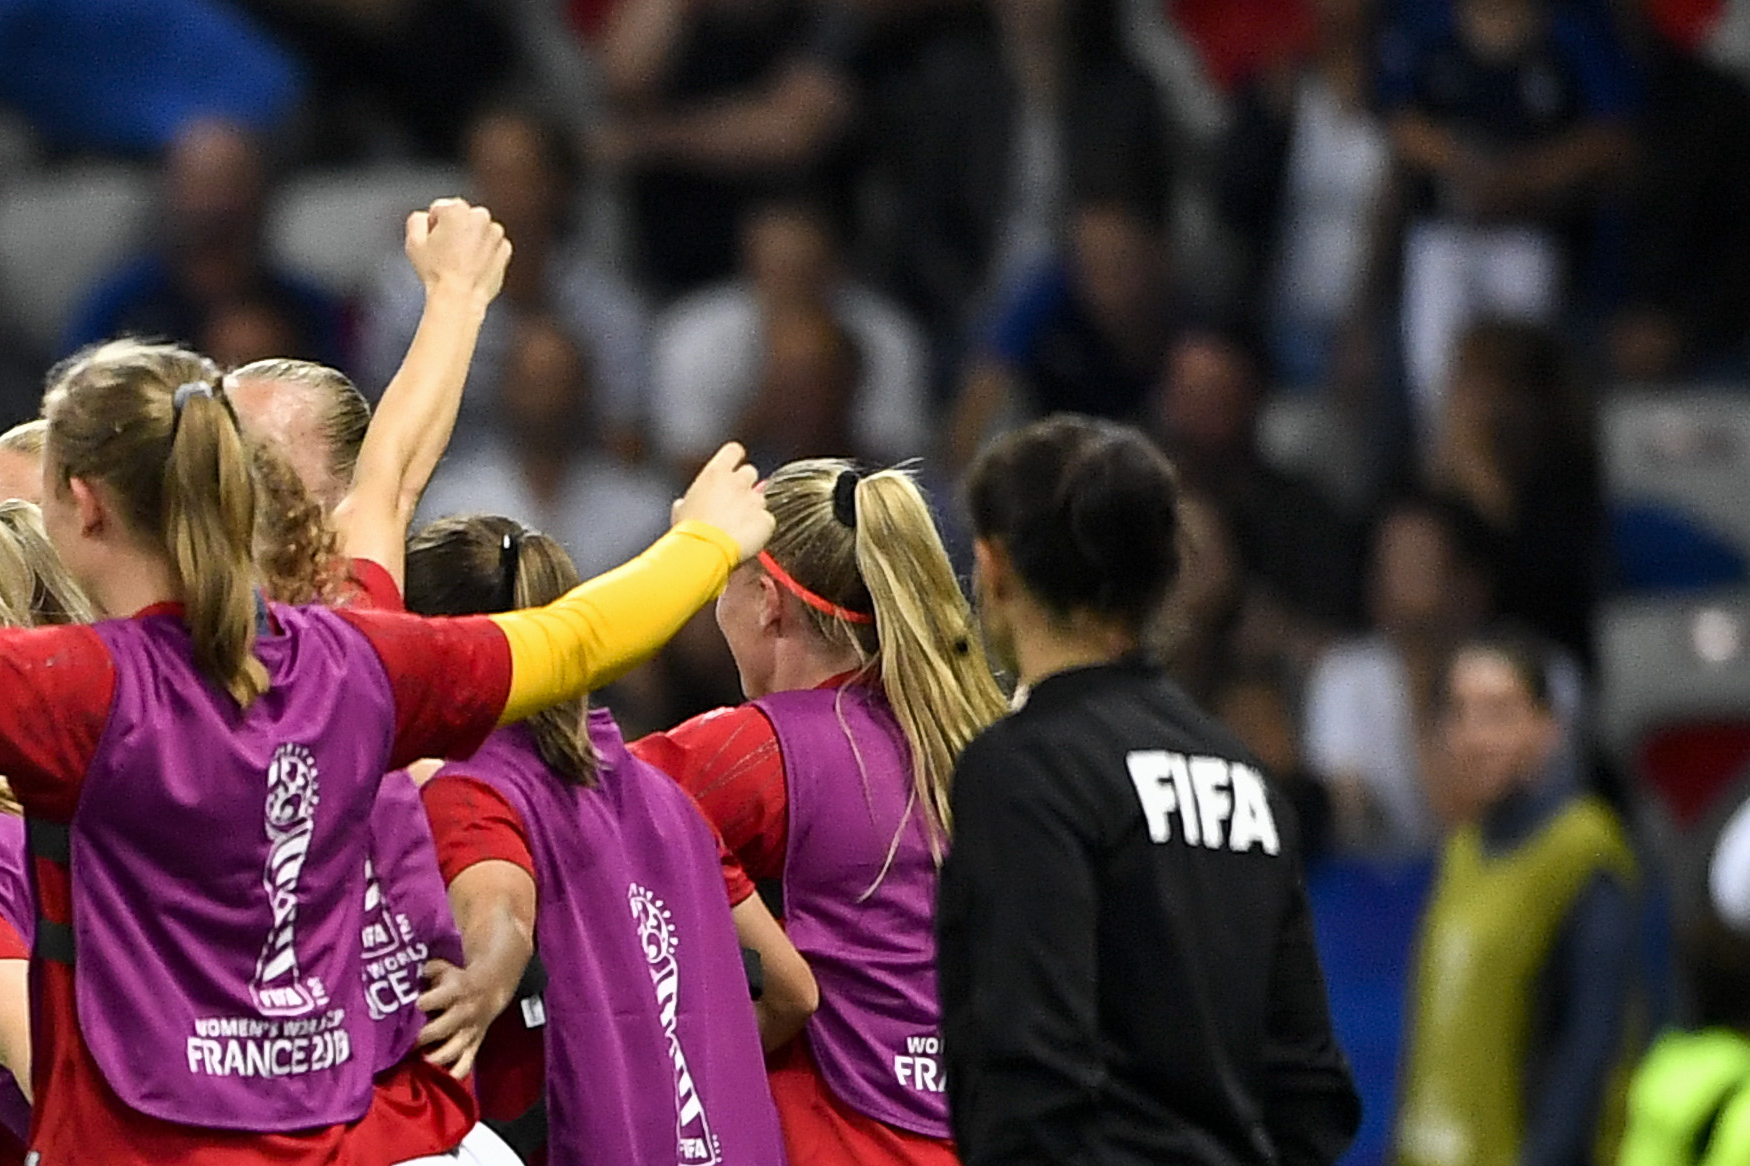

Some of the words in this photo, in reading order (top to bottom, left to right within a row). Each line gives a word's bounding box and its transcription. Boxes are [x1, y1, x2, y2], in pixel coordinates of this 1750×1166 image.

[1126, 750, 1280, 856] FIFA
[187, 1036, 309, 1079] FRANCE
[906, 1036, 945, 1055] WO
